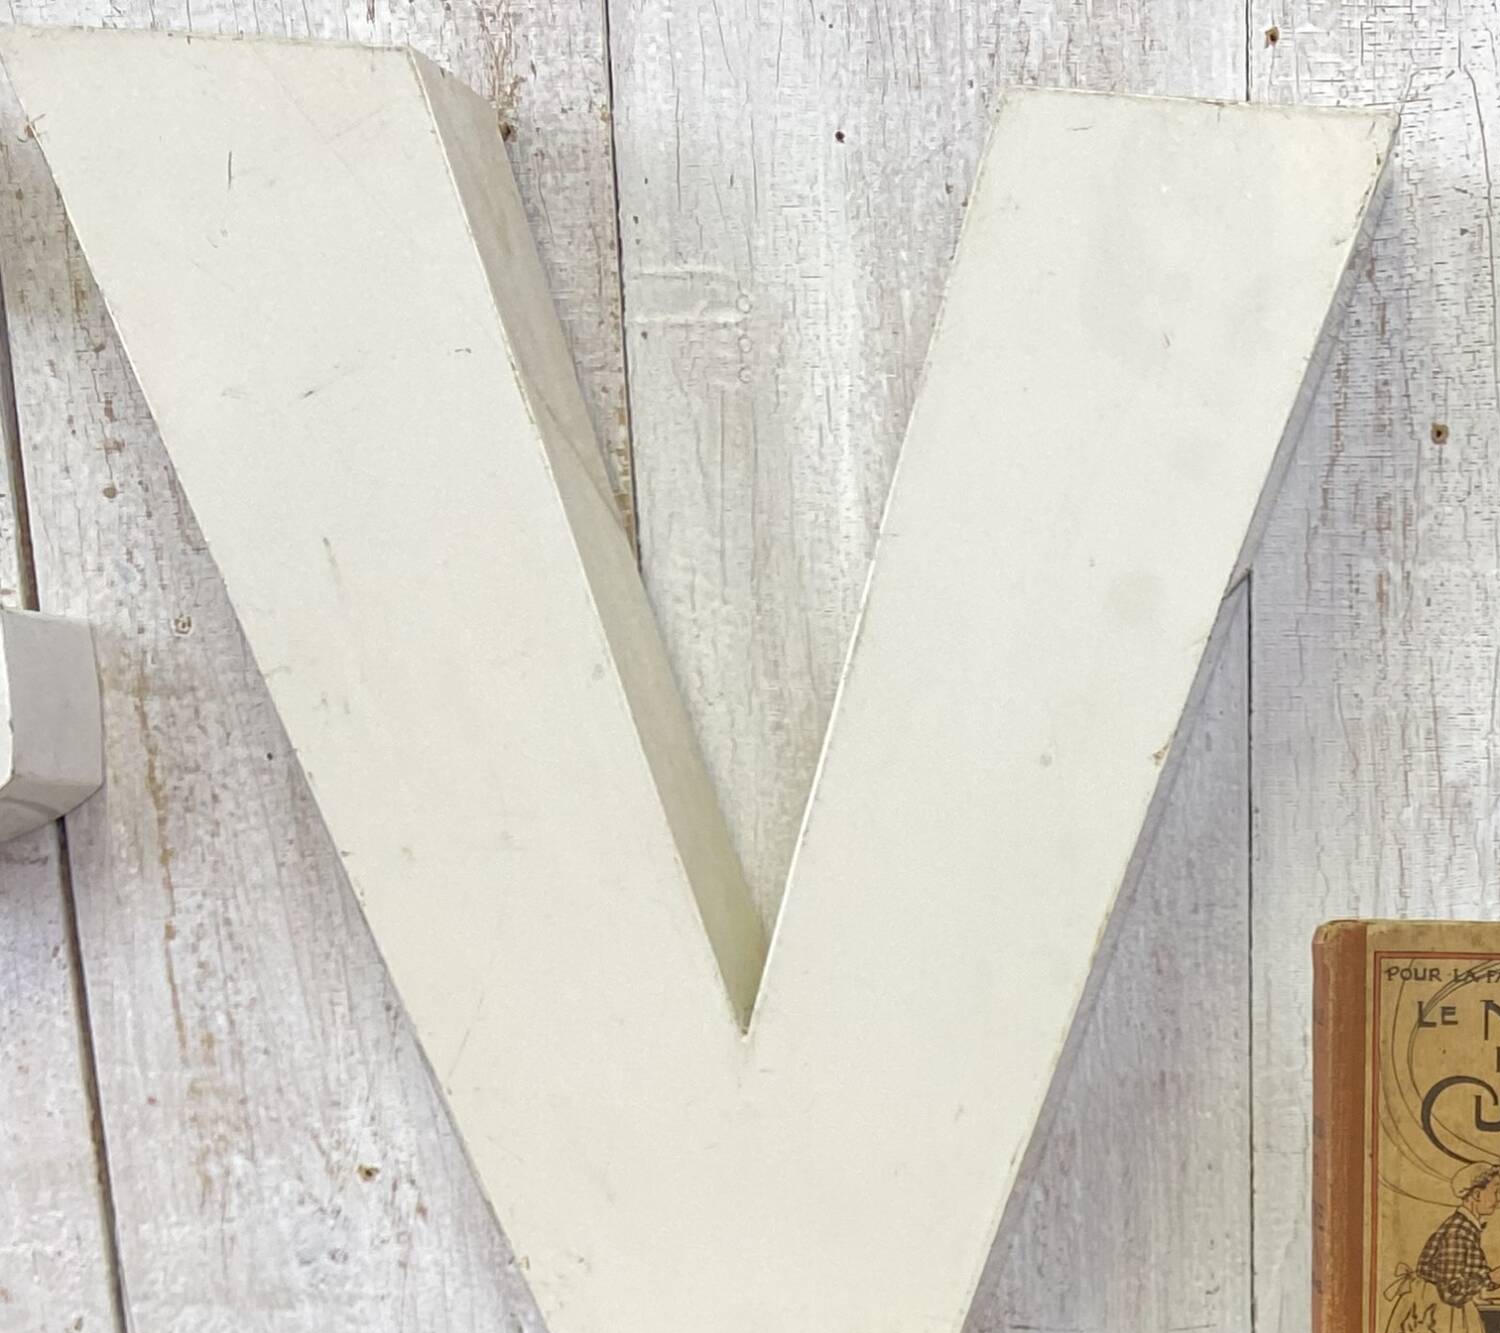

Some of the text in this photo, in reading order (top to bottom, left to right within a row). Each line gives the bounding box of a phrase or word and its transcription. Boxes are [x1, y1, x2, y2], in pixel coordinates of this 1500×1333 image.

[1385, 966, 1442, 983] POUR
[1453, 968, 1481, 984] LA
[1417, 1000, 1459, 1029] LE
